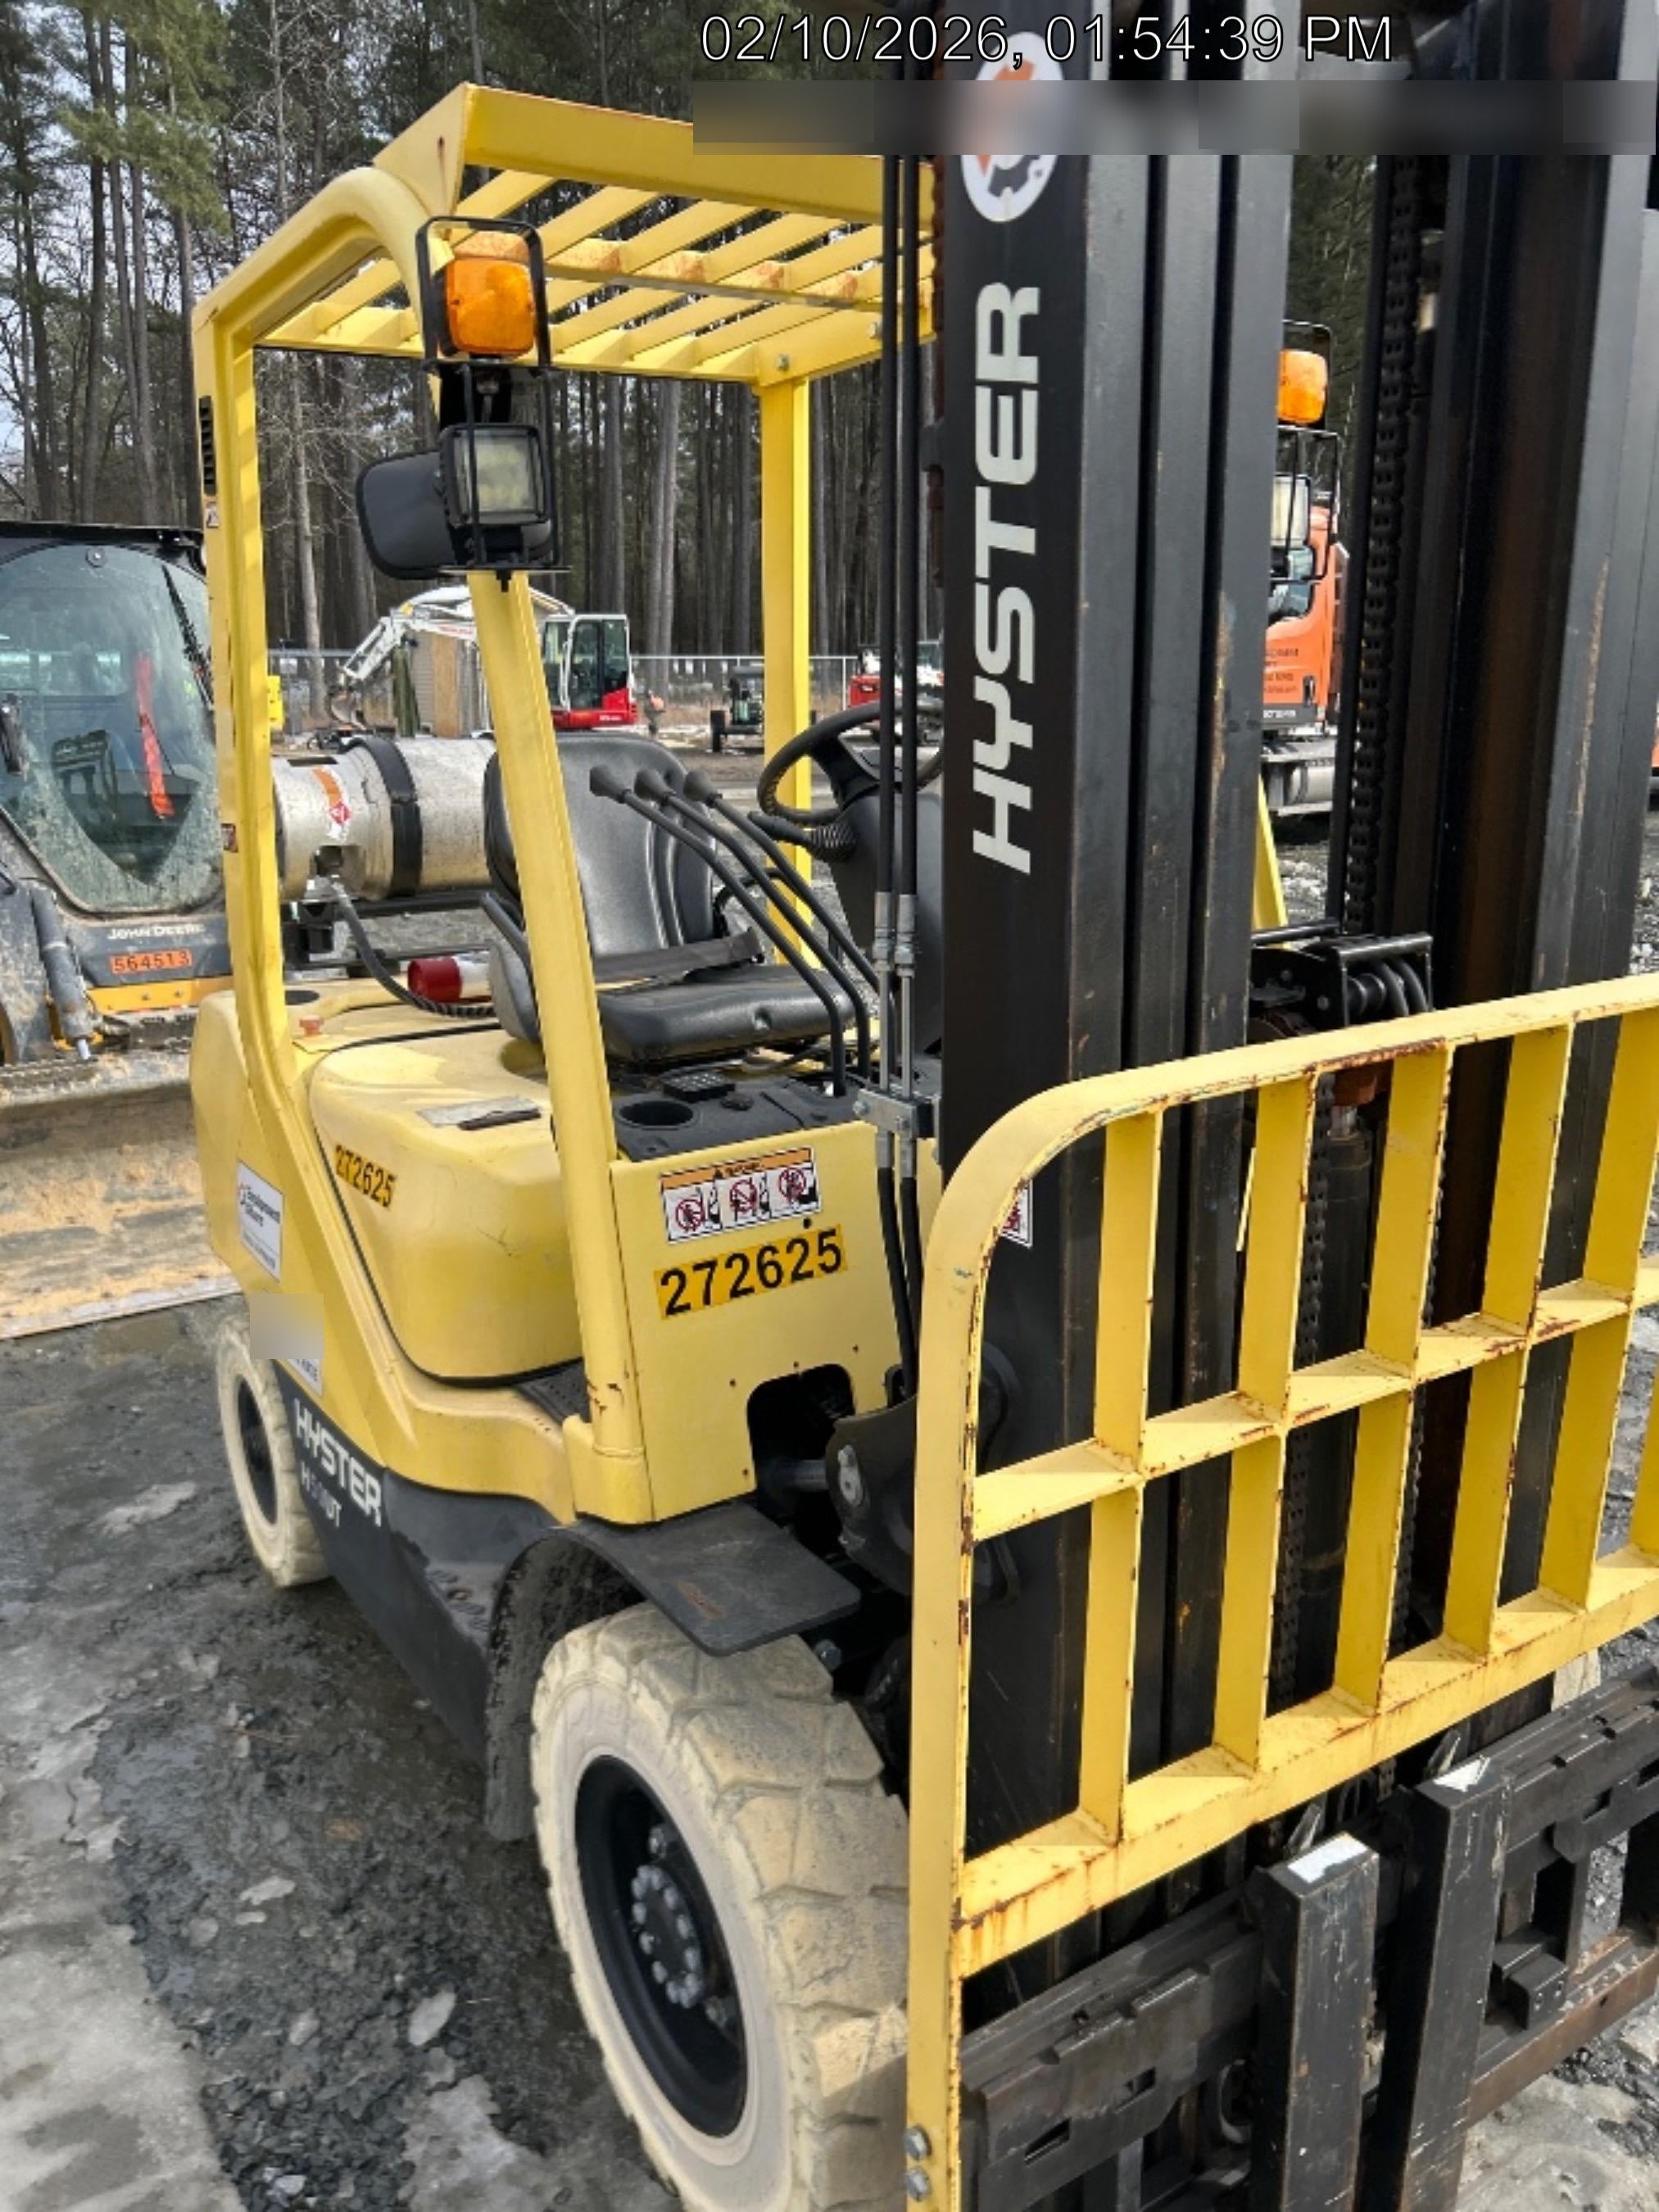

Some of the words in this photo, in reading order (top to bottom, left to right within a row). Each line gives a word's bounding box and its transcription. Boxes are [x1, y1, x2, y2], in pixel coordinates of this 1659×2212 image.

[972, 282, 1040, 875] HYSTER
[107, 927, 151, 940] JOHN
[660, 1229, 843, 1316] 272625
[294, 1398, 382, 1528] HYSTER
